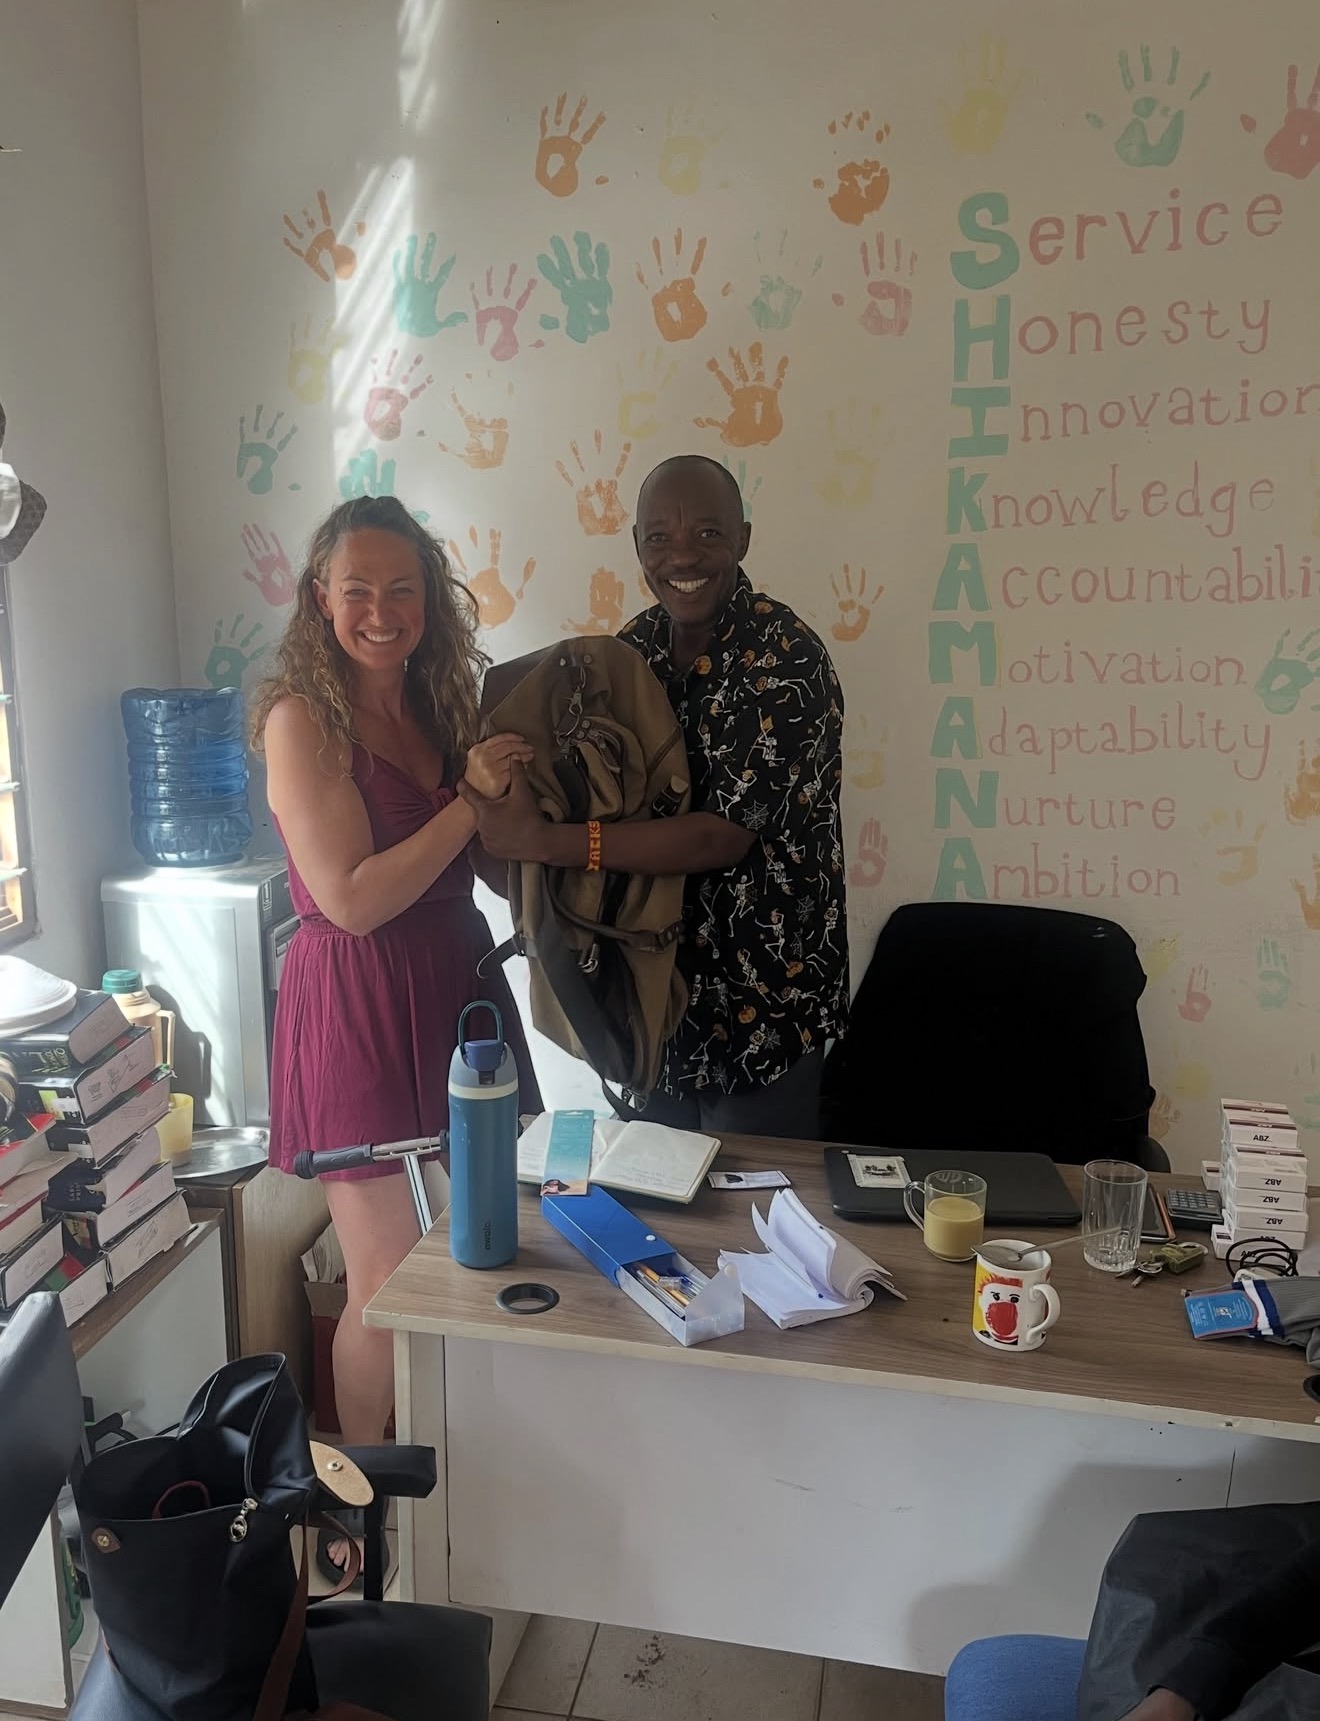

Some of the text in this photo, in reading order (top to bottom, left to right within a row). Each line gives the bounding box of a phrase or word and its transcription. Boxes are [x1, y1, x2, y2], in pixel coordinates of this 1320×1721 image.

[950, 188, 1282, 290] Service
[953, 294, 1271, 382] Honesty
[945, 459, 1275, 537] Knowledge
[932, 543, 1320, 612] Accountabili
[928, 620, 1247, 687] Motivation
[930, 695, 1271, 781] Adaptability
[934, 767, 1177, 830] Nurture
[932, 837, 1181, 900] Ambition
[1253, 1134, 1269, 1142] ABZ
[1263, 1195, 1280, 1204] ABZ
[1265, 1178, 1281, 1186] ABZ
